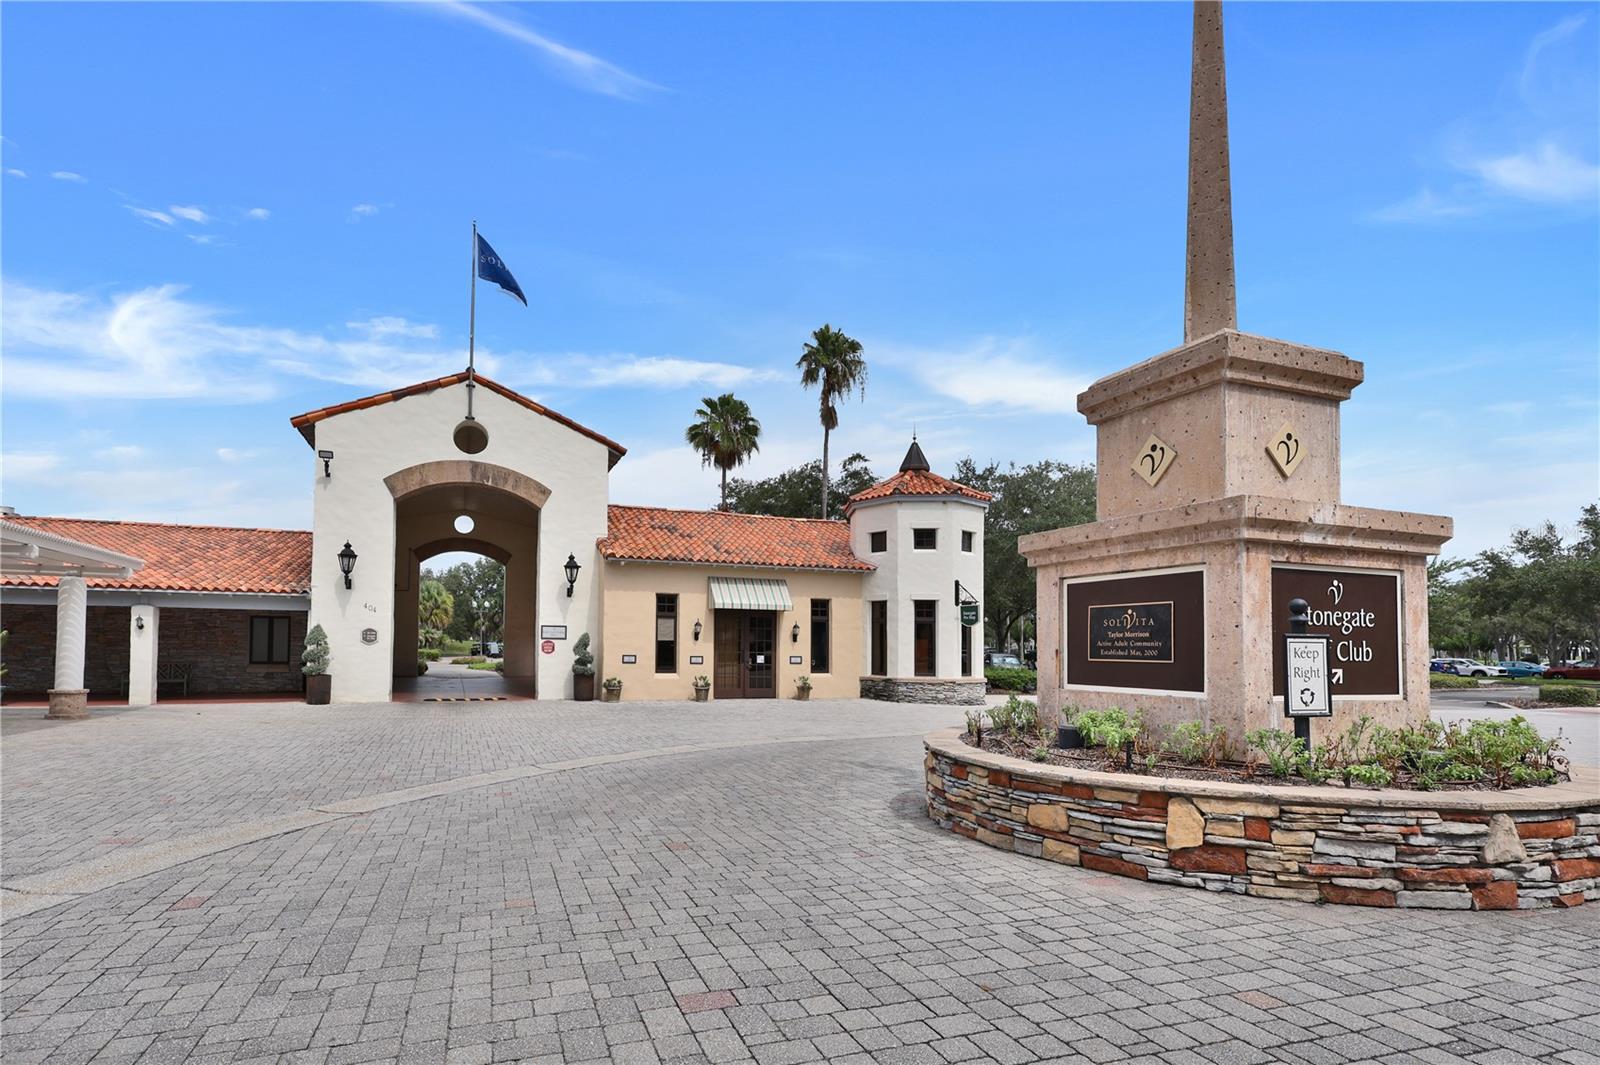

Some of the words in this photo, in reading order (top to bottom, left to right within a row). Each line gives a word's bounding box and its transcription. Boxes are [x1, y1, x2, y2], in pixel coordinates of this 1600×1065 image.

[1103, 609, 1154, 629] SOLIVITA
[1302, 606, 1375, 635] tonegate
[1129, 640, 1162, 648] Community
[1336, 640, 1373, 662] Club
[1293, 647, 1319, 662] Keep
[1293, 666, 1320, 682] Right
